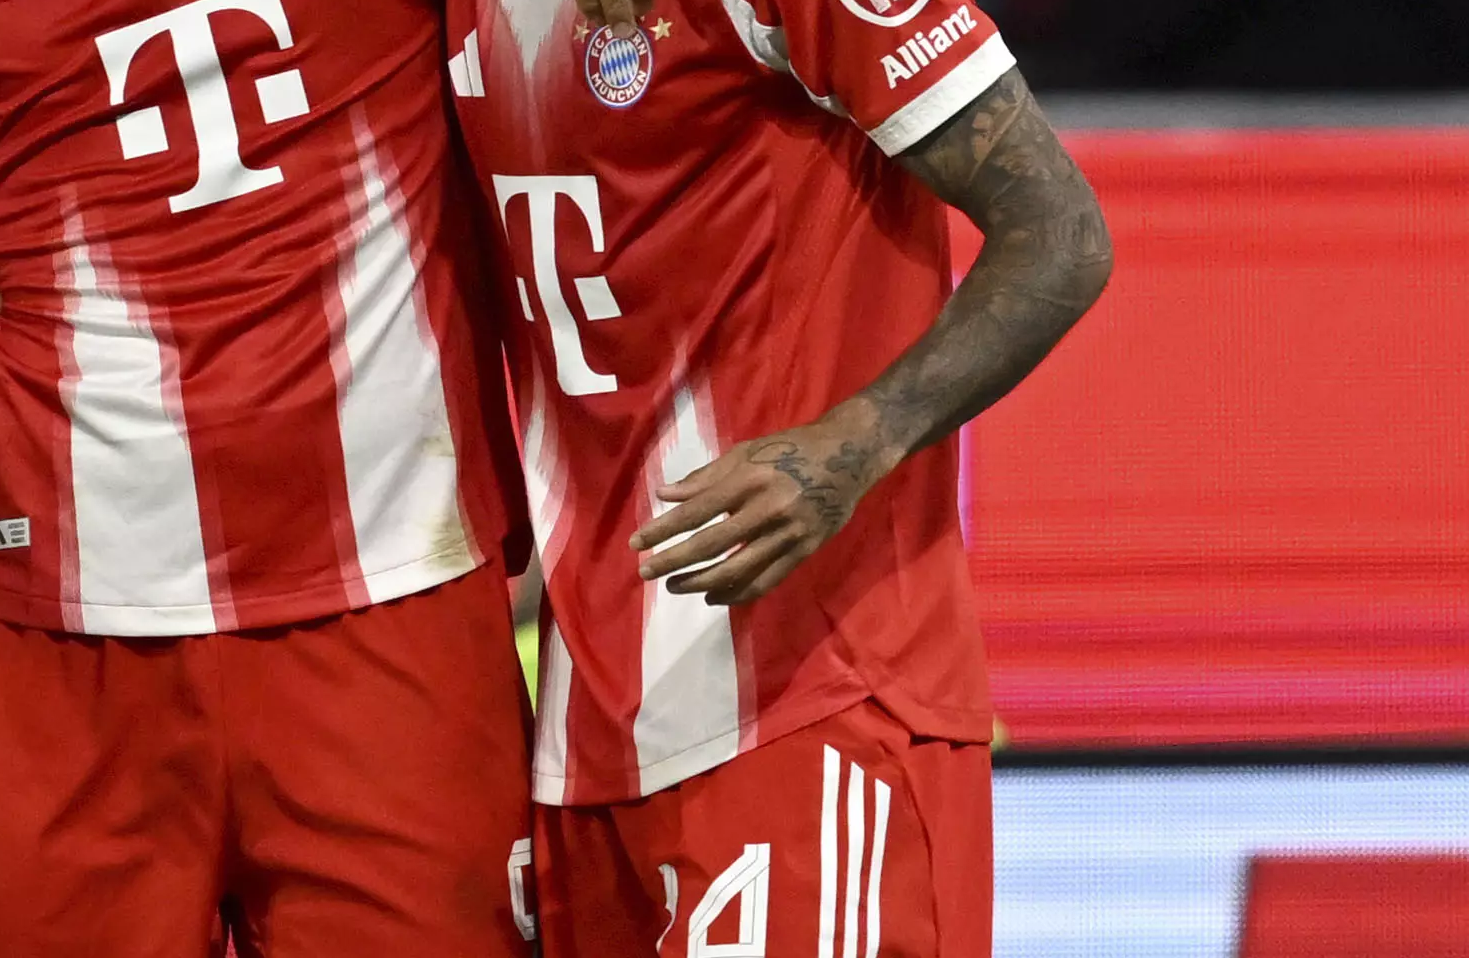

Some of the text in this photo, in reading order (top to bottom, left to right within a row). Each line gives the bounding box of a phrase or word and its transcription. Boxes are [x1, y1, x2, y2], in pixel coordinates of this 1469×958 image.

[591, 38, 605, 58] FC
[880, 4, 977, 89] Allianz
[492, 173, 618, 396] T
[656, 843, 771, 958] 4
